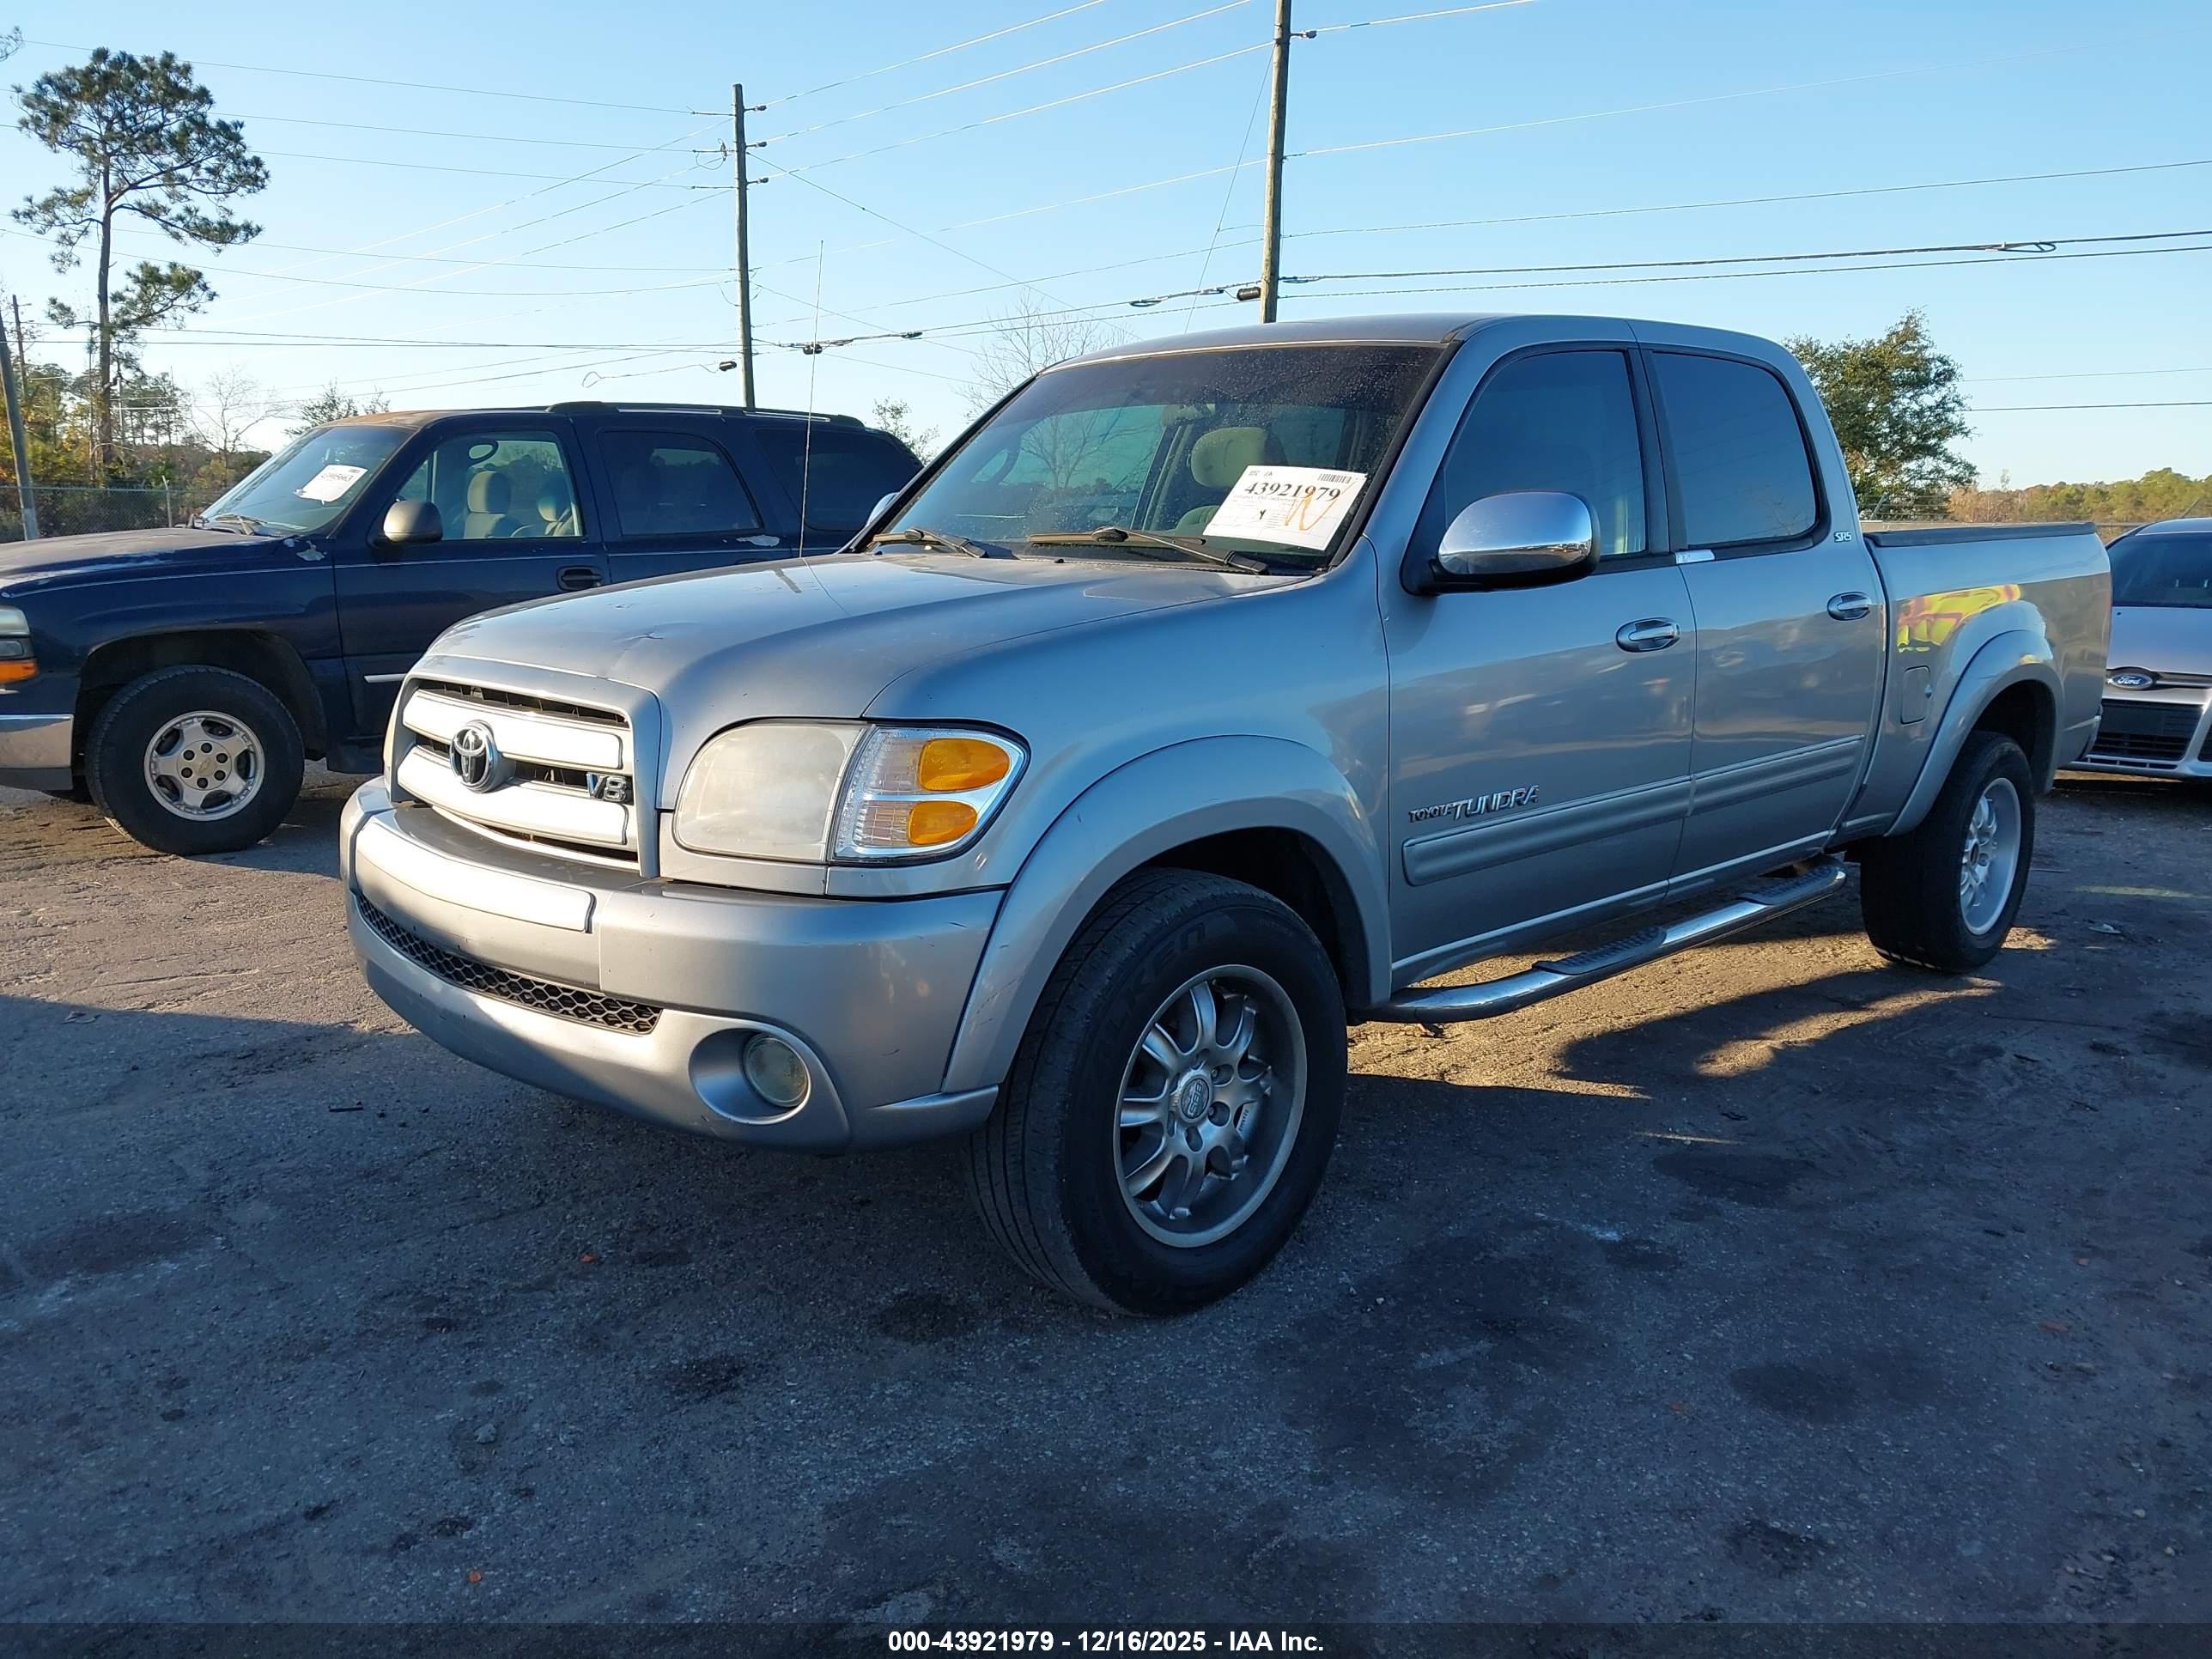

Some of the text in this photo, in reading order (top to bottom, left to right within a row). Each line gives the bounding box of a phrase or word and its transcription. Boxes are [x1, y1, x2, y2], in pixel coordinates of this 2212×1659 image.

[1244, 482, 1341, 501] 43921979
[1834, 531, 1852, 542] SR5
[2118, 675, 2141, 684] Ford
[586, 771, 627, 802] V8
[1408, 785, 1540, 823] TOYOTA TUNDRA
